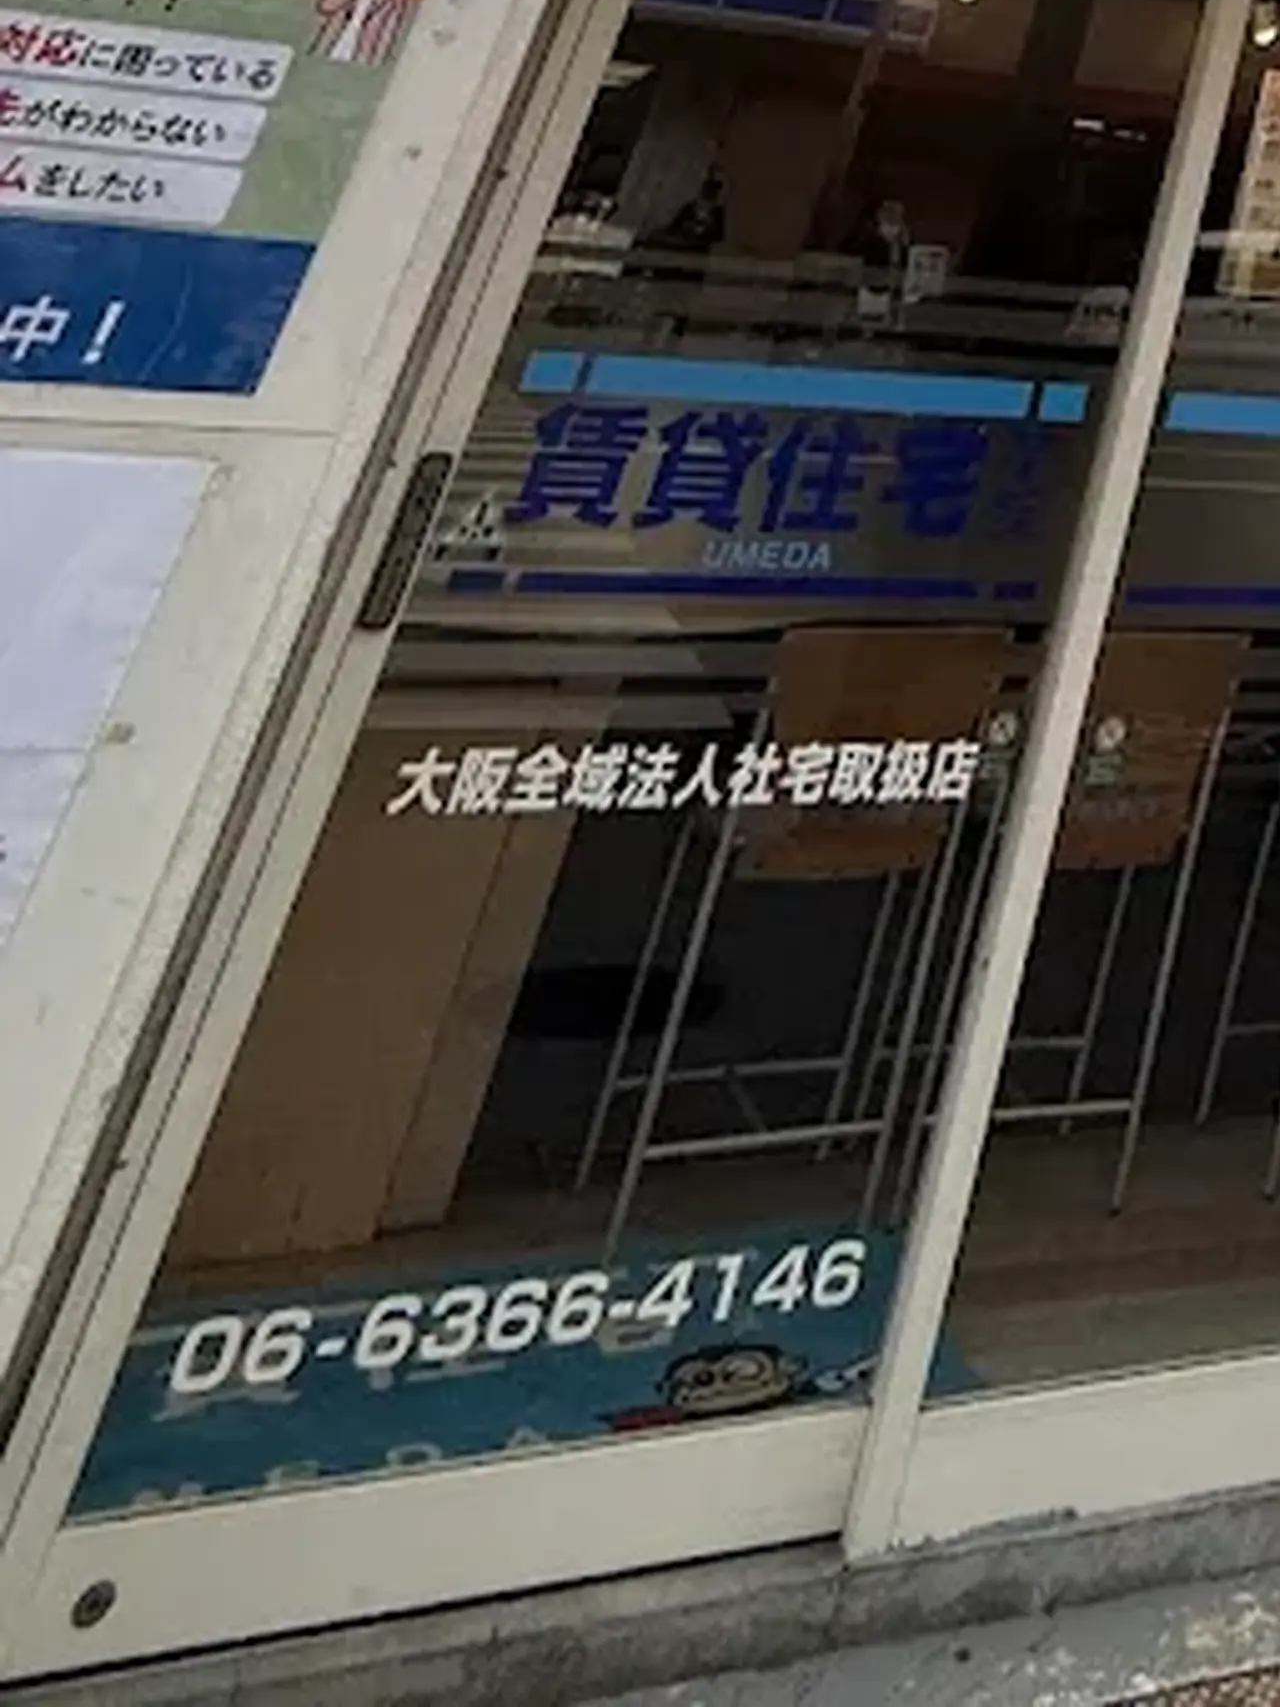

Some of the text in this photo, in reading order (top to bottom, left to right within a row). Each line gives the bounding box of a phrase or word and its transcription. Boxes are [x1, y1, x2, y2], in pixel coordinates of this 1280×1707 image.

[505, 402, 992, 537] 賃貸住宅
[700, 539, 834, 573] UMEDA
[398, 740, 982, 813] 大阪全域法人社宅取扱店
[170, 1241, 866, 1393] 06-6366-4146
